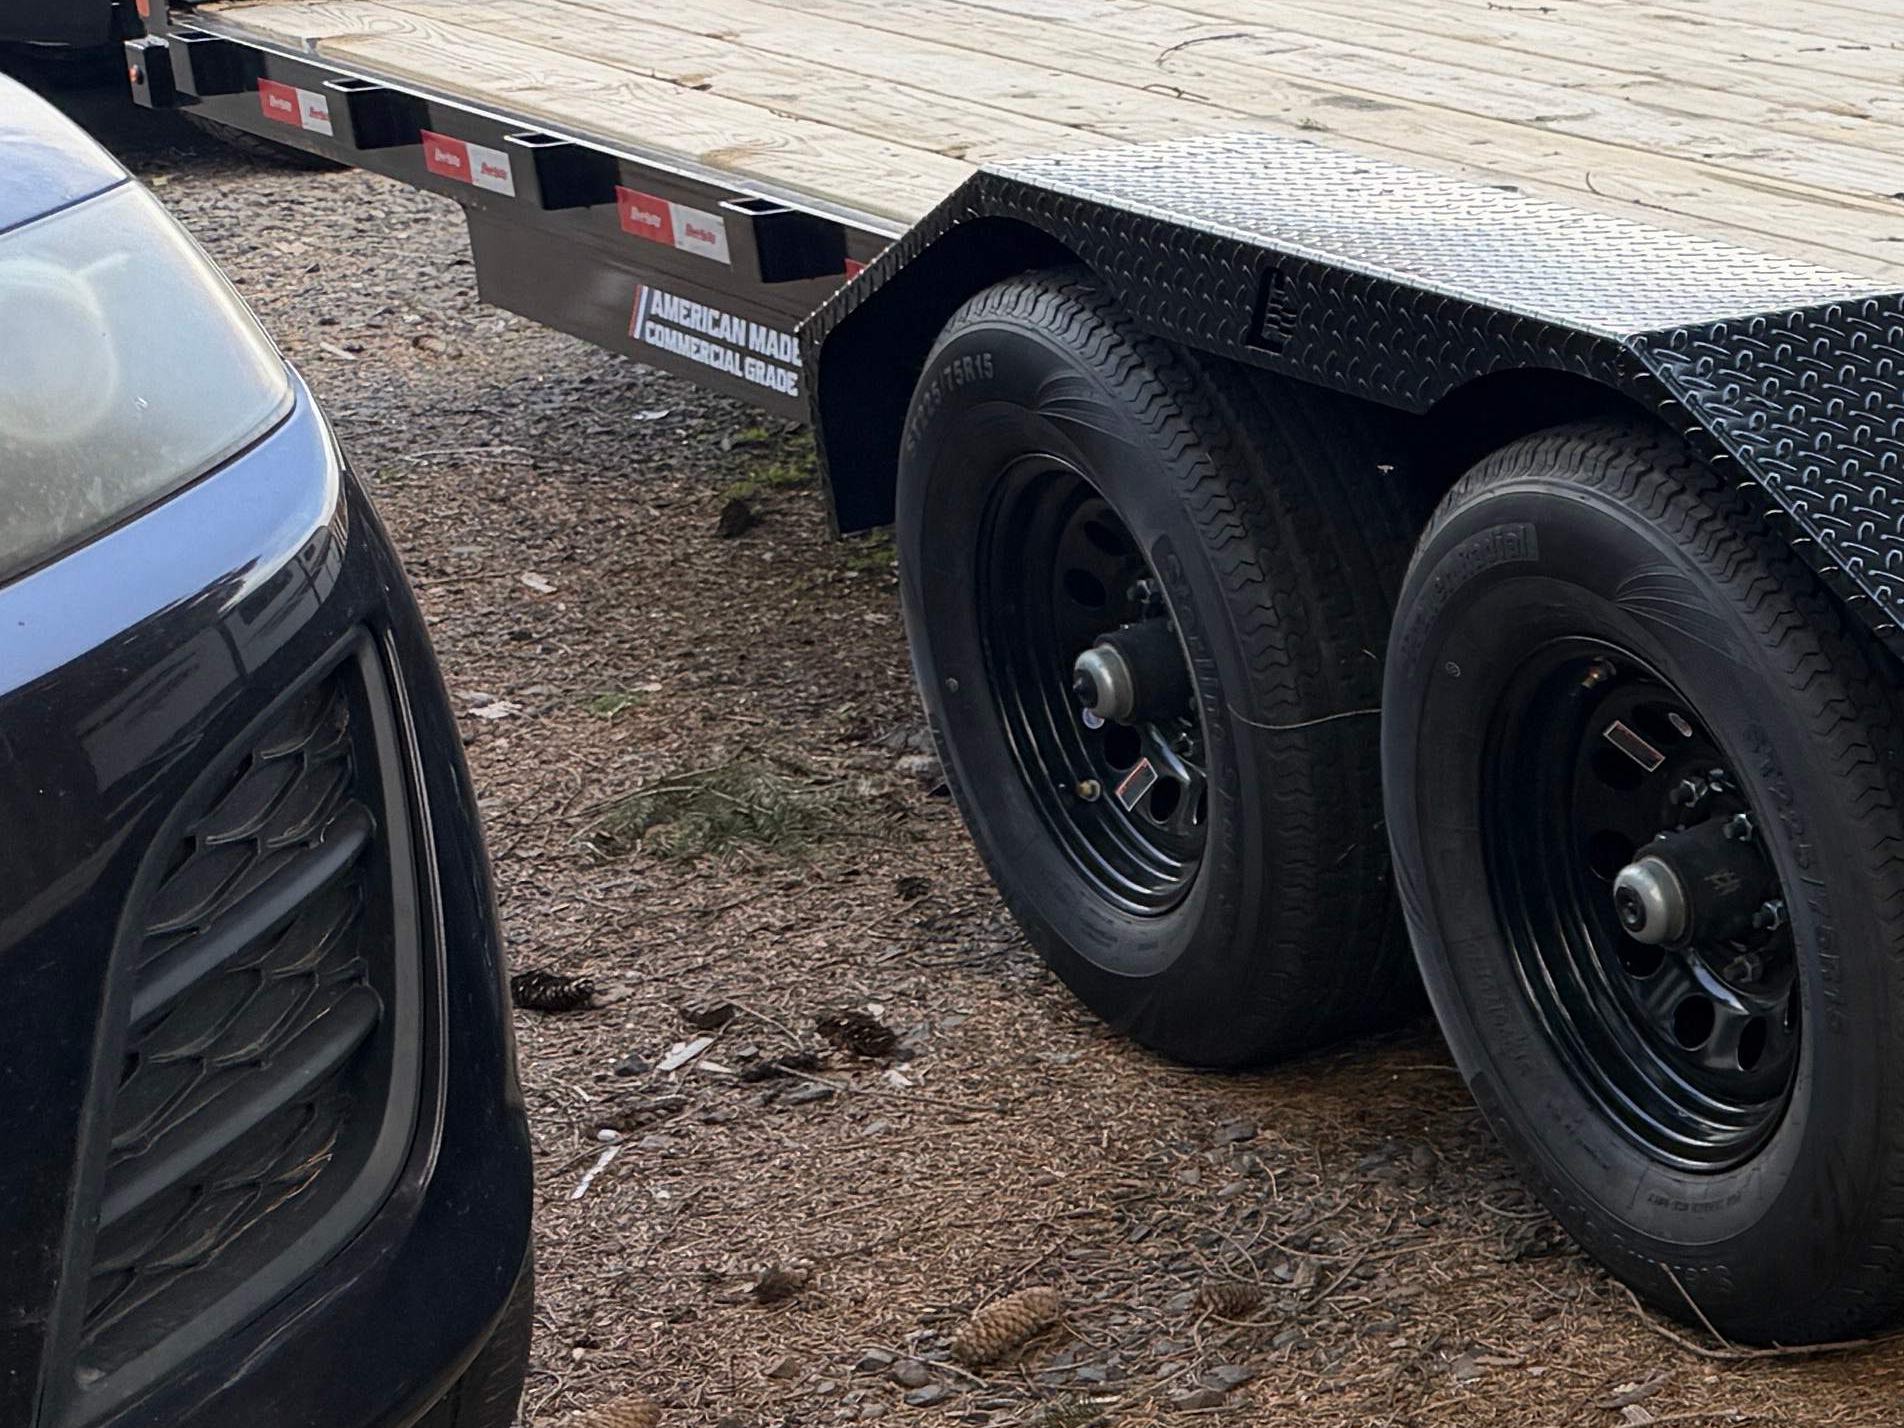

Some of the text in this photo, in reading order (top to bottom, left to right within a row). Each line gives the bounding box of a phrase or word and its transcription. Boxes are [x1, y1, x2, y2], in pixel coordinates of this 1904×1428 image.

[651, 289, 746, 347] AMERICAN
[645, 321, 799, 397] COMMERCIAL GRADE
